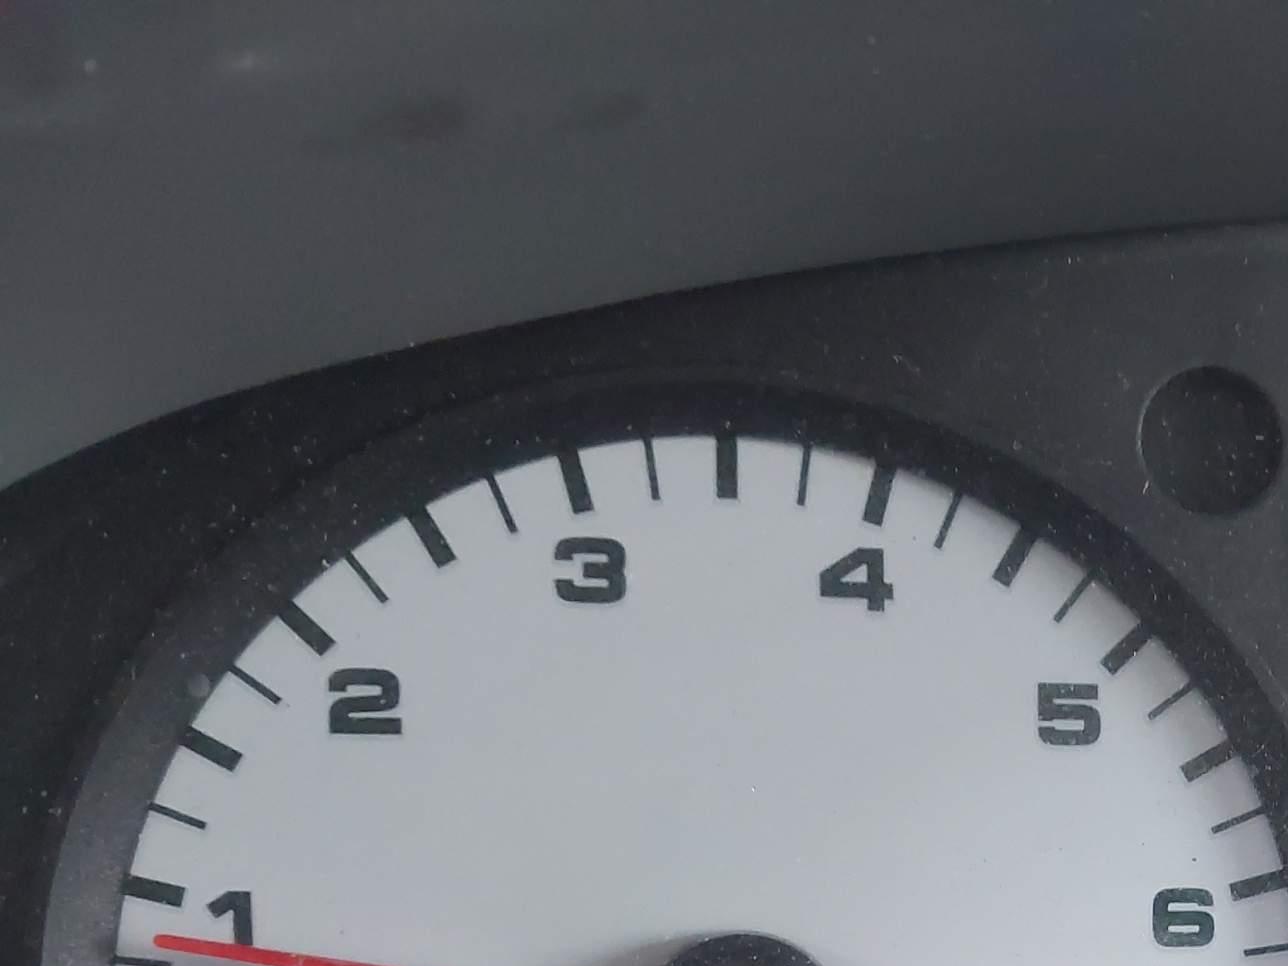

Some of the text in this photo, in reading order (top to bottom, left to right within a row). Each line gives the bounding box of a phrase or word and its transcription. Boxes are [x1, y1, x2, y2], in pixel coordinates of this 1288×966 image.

[554, 537, 627, 603] 3
[819, 547, 893, 612] 4
[329, 667, 403, 735] 2
[1037, 682, 1101, 746] 5
[206, 890, 254, 946] 1
[1152, 888, 1215, 948] 6
